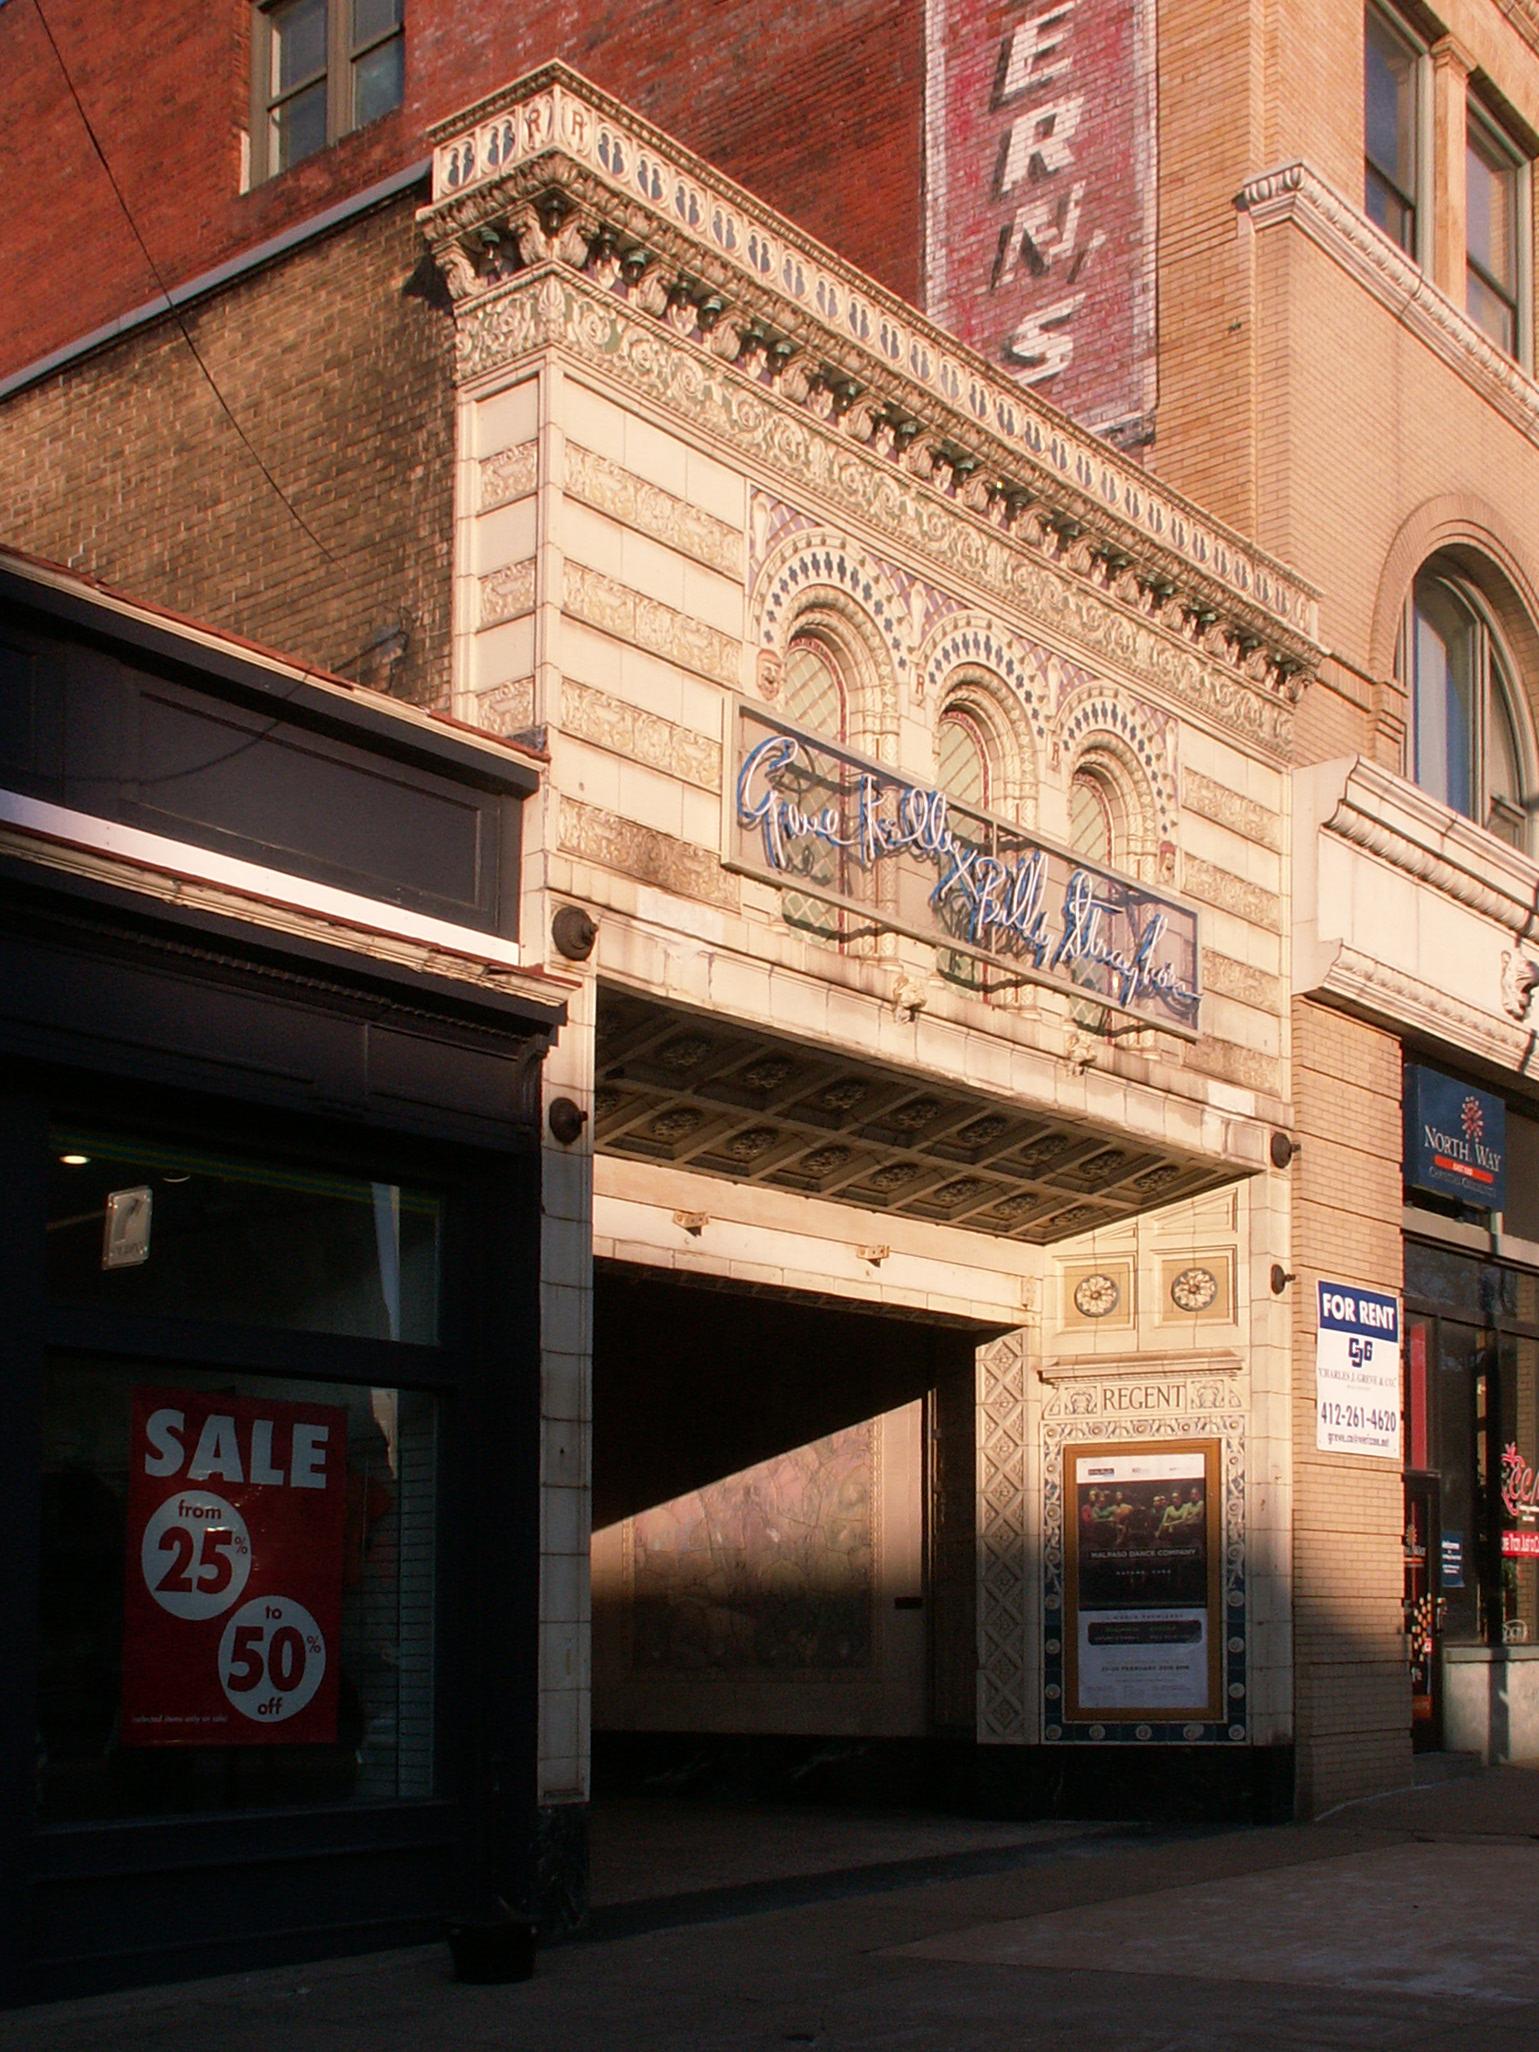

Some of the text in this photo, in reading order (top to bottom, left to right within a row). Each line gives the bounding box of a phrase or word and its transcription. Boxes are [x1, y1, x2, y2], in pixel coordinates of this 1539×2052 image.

[1323, 1293, 1395, 1331] FOR RENT
[1103, 1385, 1186, 1411] REGENT
[1321, 1401, 1397, 1432] 412-261-4620
[144, 1408, 330, 1489] SALE
[178, 1499, 222, 1520] from
[265, 1605, 283, 1620] to
[257, 1697, 283, 1716] off
